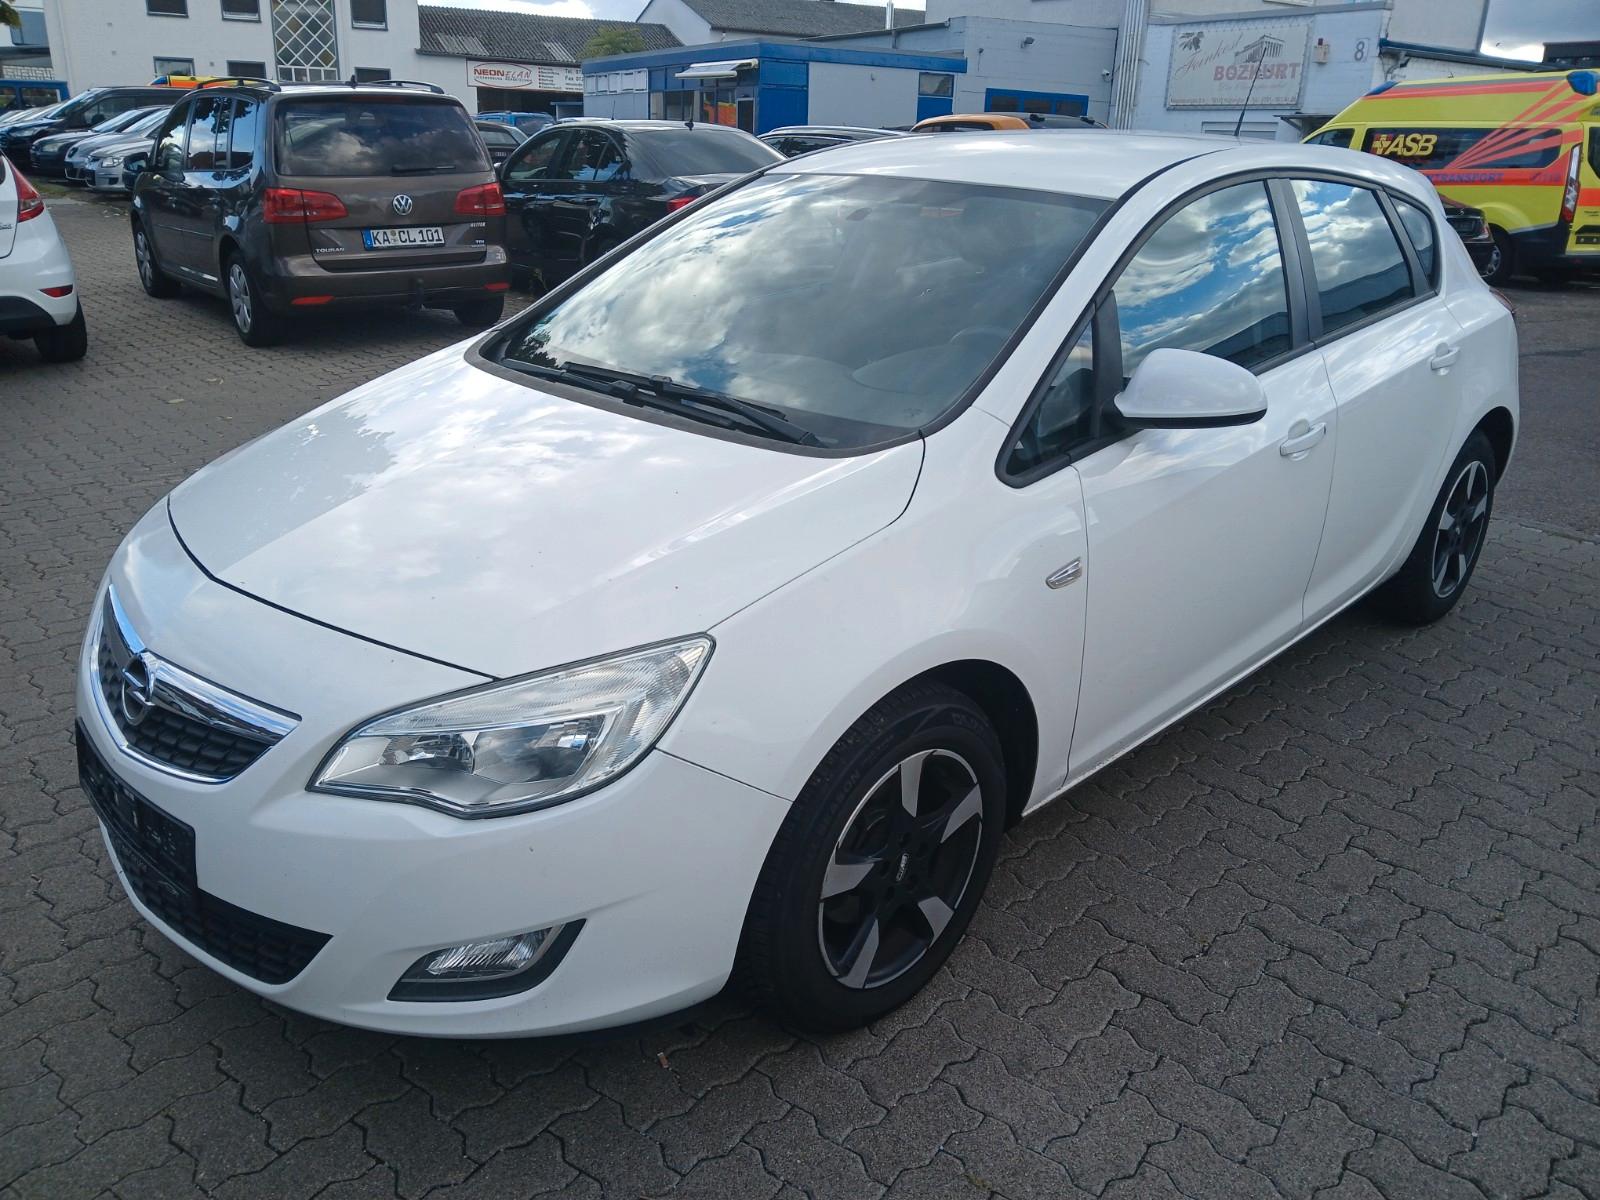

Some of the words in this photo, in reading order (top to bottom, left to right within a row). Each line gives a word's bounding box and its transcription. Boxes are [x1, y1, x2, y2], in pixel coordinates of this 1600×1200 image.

[1354, 41, 1365, 61] 8
[474, 68, 505, 77] NEON
[506, 71, 531, 79] ELAN
[1213, 62, 1301, 81] BOZKURT
[1384, 133, 1437, 156] ASB
[373, 231, 391, 246] KA
[398, 229, 415, 244] CL
[418, 228, 443, 242] 101
